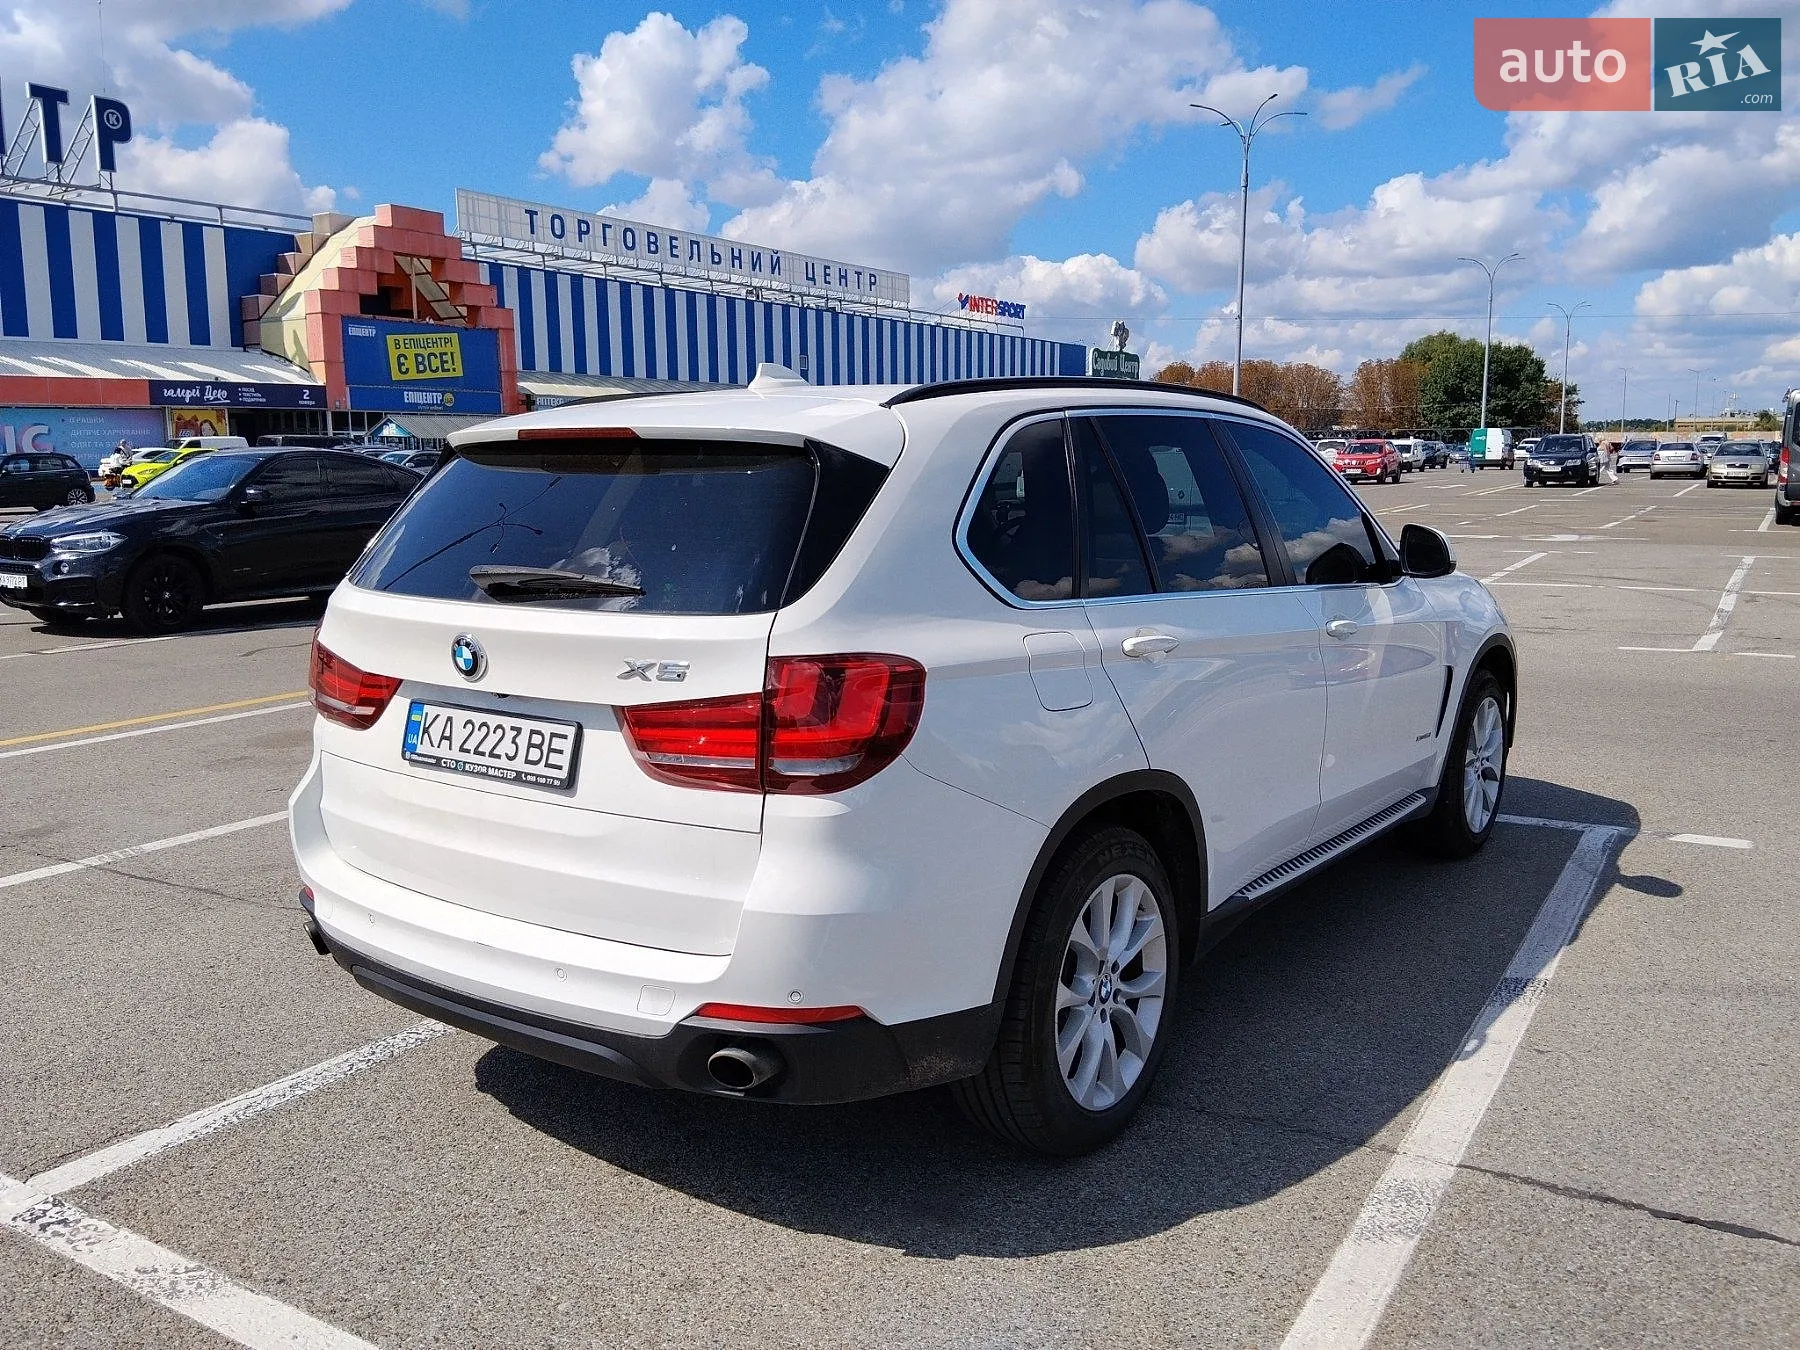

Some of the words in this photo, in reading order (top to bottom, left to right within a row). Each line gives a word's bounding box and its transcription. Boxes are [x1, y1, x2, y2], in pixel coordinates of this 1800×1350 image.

[524, 209, 782, 276] ТОРГОВЕЛЬНИЙ
[805, 261, 877, 292] ЦЕНТР
[968, 295, 1026, 320] INTERSPORT
[394, 338, 402, 350] В
[404, 336, 453, 351] ЕПІЦЕНТРІ
[396, 353, 410, 375] Є
[414, 351, 457, 375] ВСЕ!
[203, 384, 229, 402] Деко
[302, 389, 311, 400] 2
[616, 658, 691, 682] X5
[407, 733, 418, 745] UA
[420, 711, 454, 751] KA
[458, 718, 523, 762] 2223
[523, 728, 569, 771] BE
[441, 758, 456, 769] СТО
[487, 767, 517, 779] МАСТЕР
